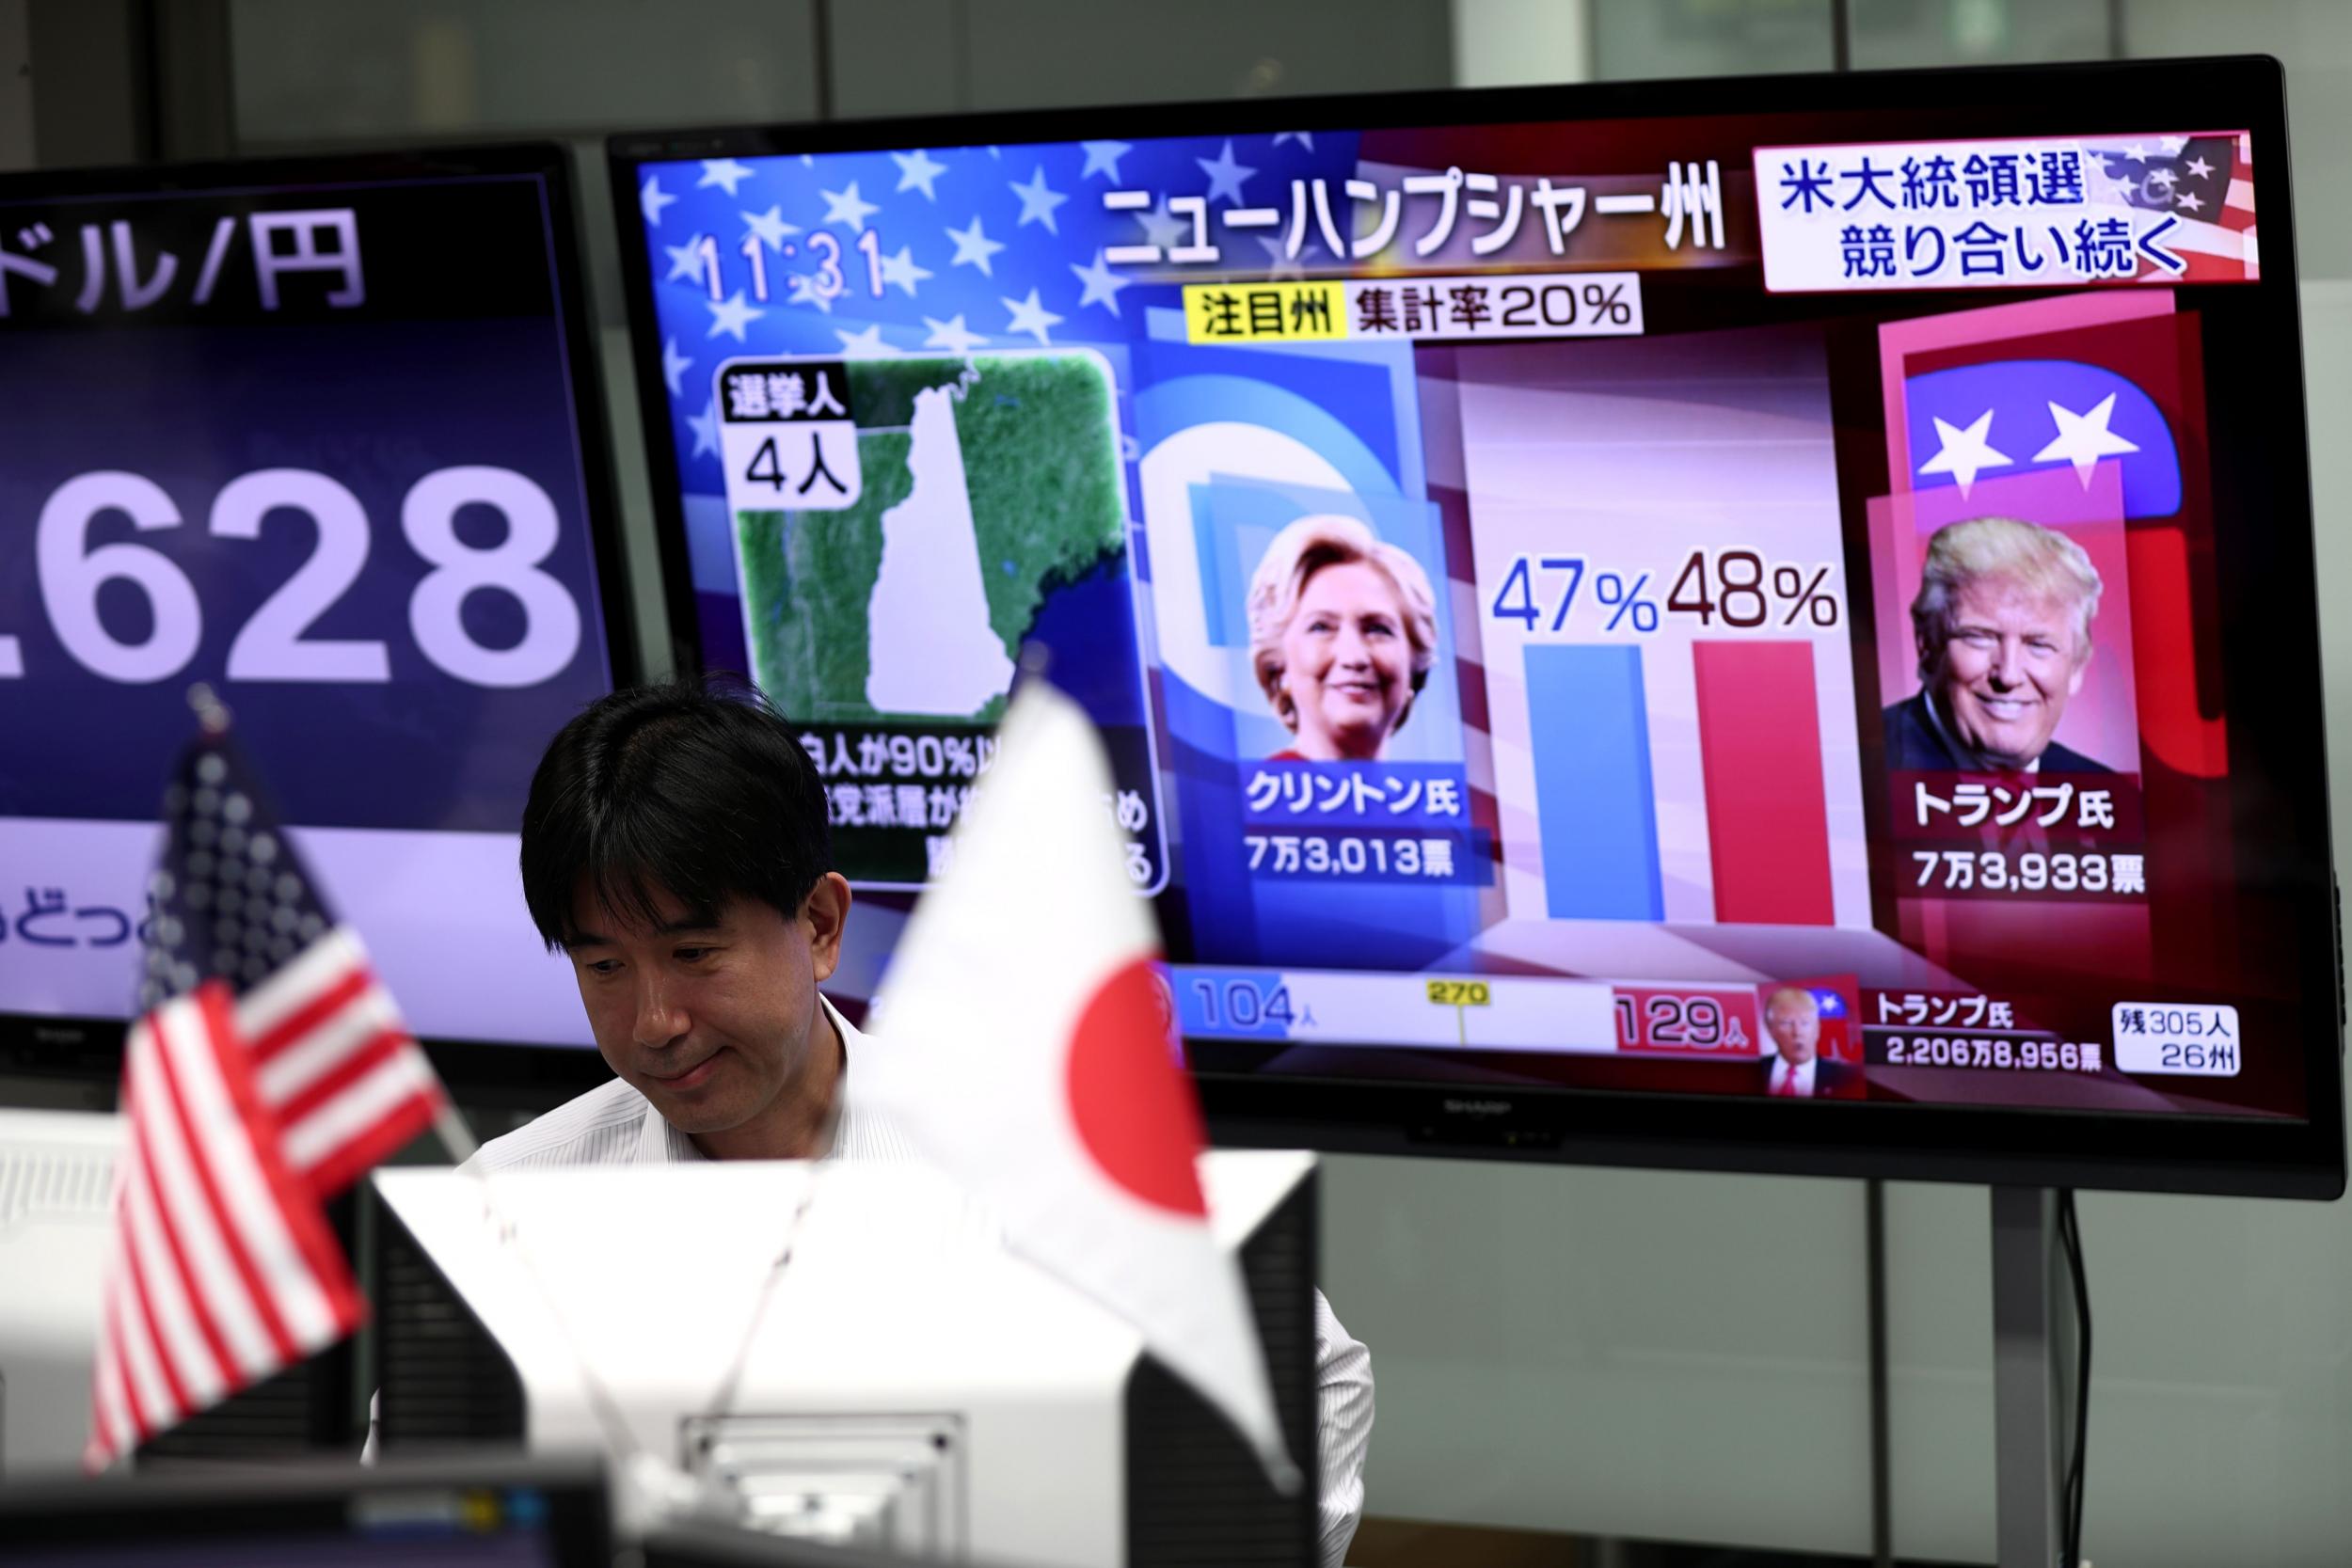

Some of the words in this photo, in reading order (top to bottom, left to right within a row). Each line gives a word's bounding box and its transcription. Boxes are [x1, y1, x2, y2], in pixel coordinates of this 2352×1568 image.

[1779, 150, 2085, 213] 米大統領選
[1103, 160, 1725, 263] ニューハンプシャー州
[0, 208, 366, 317] ドル/円
[697, 229, 885, 303] 11:31
[1840, 216, 2185, 278] 競り合い続く
[1200, 291, 1332, 336] 注目州
[1356, 284, 1632, 333] 集計率20%
[726, 371, 846, 420] 選挙人
[743, 431, 847, 495] 4人
[1492, 557, 1660, 633] 47%
[1666, 550, 1838, 628] 48%
[1244, 770, 1460, 816] クリントン氏
[1915, 782, 2115, 829] トランプ氏
[1243, 836, 1454, 878] 7万3,013票
[1913, 850, 2146, 894] 7万3,933票
[1193, 980, 1318, 1028] 104人
[1429, 982, 1488, 1005] 270
[1879, 992, 2013, 1029] トランプ氏
[1613, 997, 1747, 1049] 129人
[2120, 1007, 2232, 1038] 残305人
[1885, 1036, 2104, 1073] 2,206万8,956票
[2161, 1044, 2236, 1072] 26州
